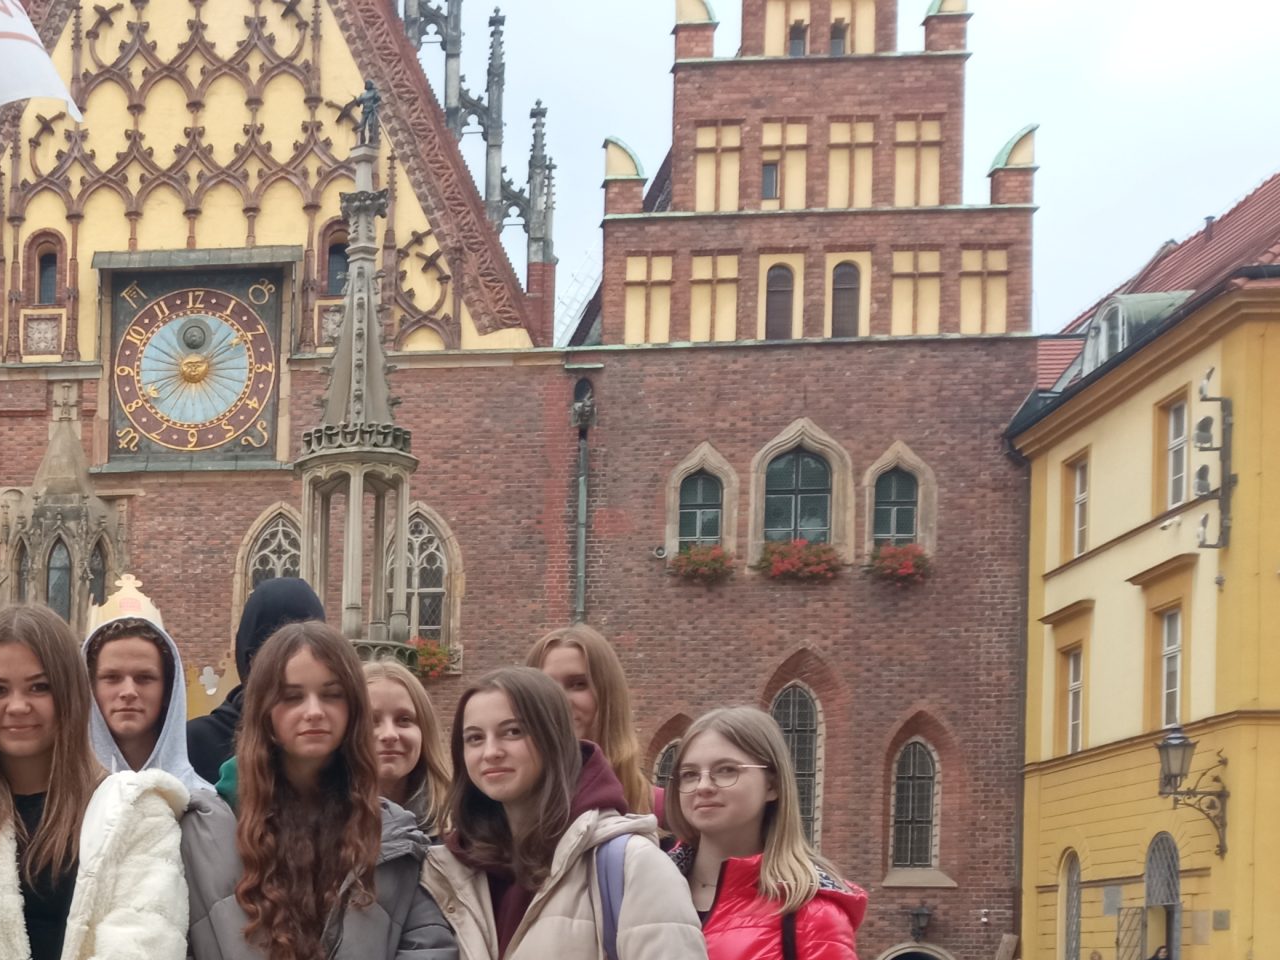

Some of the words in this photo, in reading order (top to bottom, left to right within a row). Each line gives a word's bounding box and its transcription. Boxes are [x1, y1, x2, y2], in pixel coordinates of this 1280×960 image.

[186, 291, 205, 308] 12
[153, 301, 169, 319] 11
[224, 301, 236, 315] 1
[126, 326, 146, 345] 10
[255, 362, 273, 373] 3
[126, 399, 142, 412] 8
[246, 398, 260, 410] 4
[151, 424, 167, 439] 7
[221, 420, 234, 437] 5
